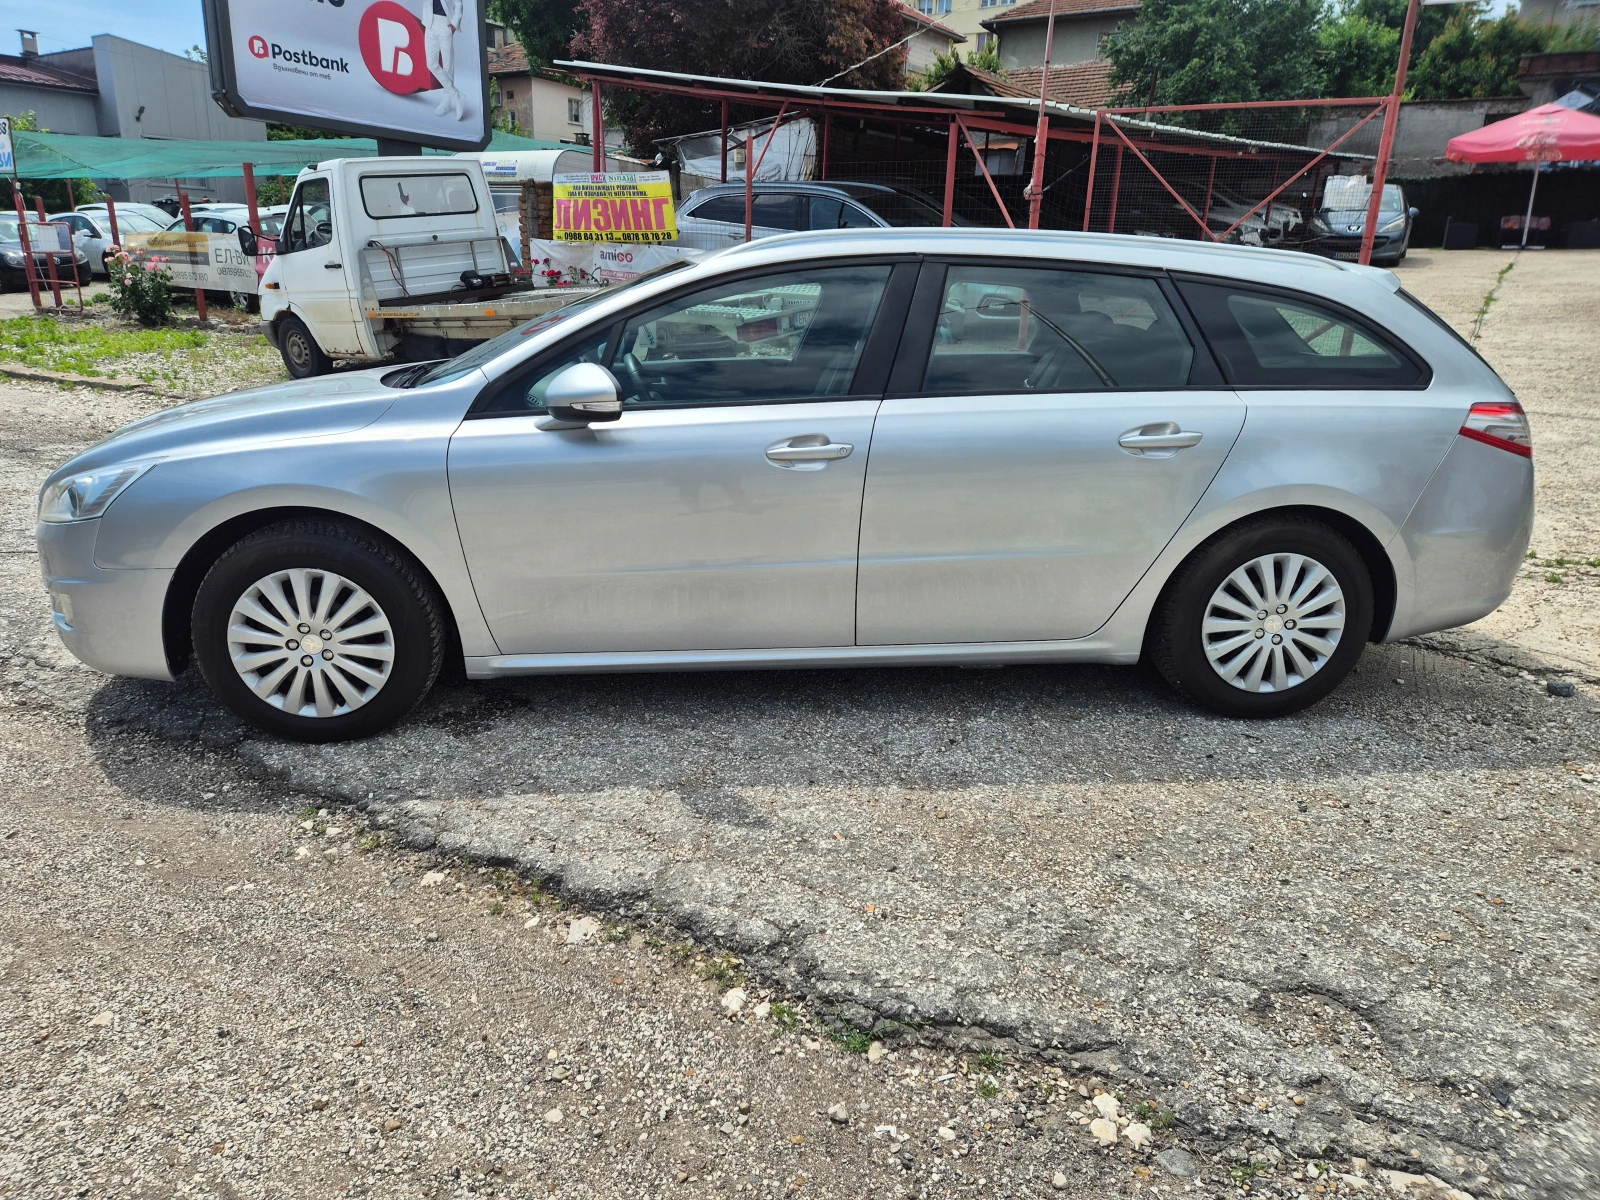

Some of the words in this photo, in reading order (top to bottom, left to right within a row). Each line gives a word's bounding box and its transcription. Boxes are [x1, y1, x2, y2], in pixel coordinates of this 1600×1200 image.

[271, 43, 349, 73] Postbank
[273, 63, 308, 76] Вдъхновени
[555, 198, 670, 231] ЛИЗИНГ
[594, 232, 604, 241] 31
[604, 232, 614, 240] 13
[622, 232, 640, 240] 0878
[661, 231, 672, 240] 28
